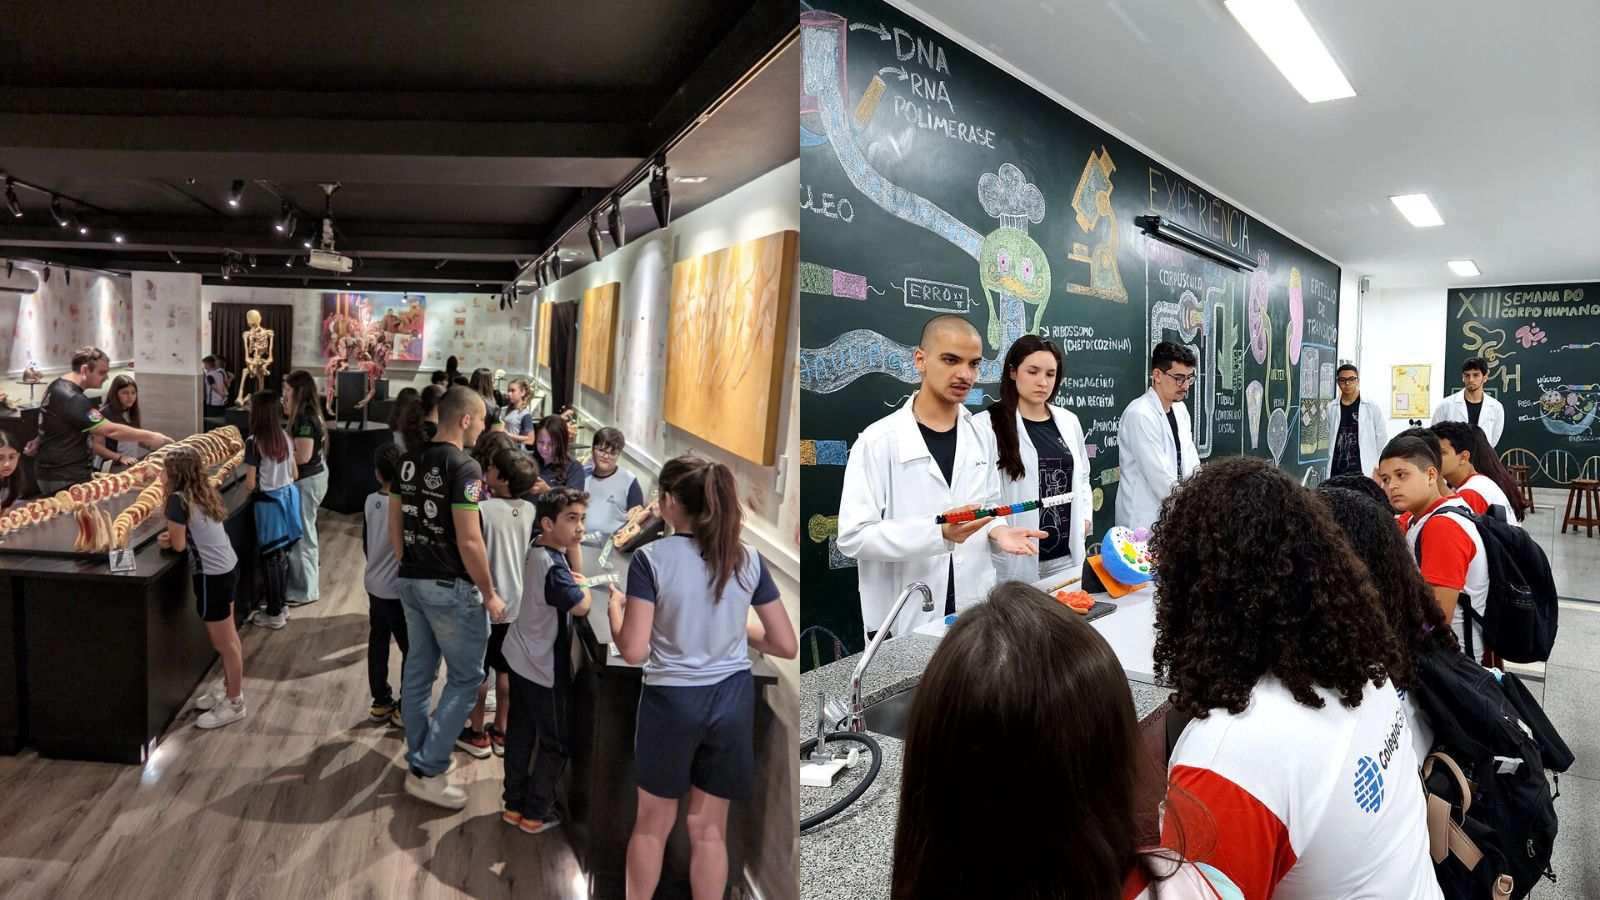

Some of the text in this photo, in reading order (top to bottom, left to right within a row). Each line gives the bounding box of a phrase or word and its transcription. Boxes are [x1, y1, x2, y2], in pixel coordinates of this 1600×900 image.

[893, 28, 951, 75] DNA
[909, 72, 955, 113] RNA
[910, 283, 951, 302] ERRO
[1503, 288, 1585, 307] SEMANA DO
[1456, 291, 1501, 319] XIII
[1501, 303, 1600, 319] CORPO HUMANO
[1052, 325, 1095, 338] RIBOSSOMO
[1076, 395, 1087, 408] DA
